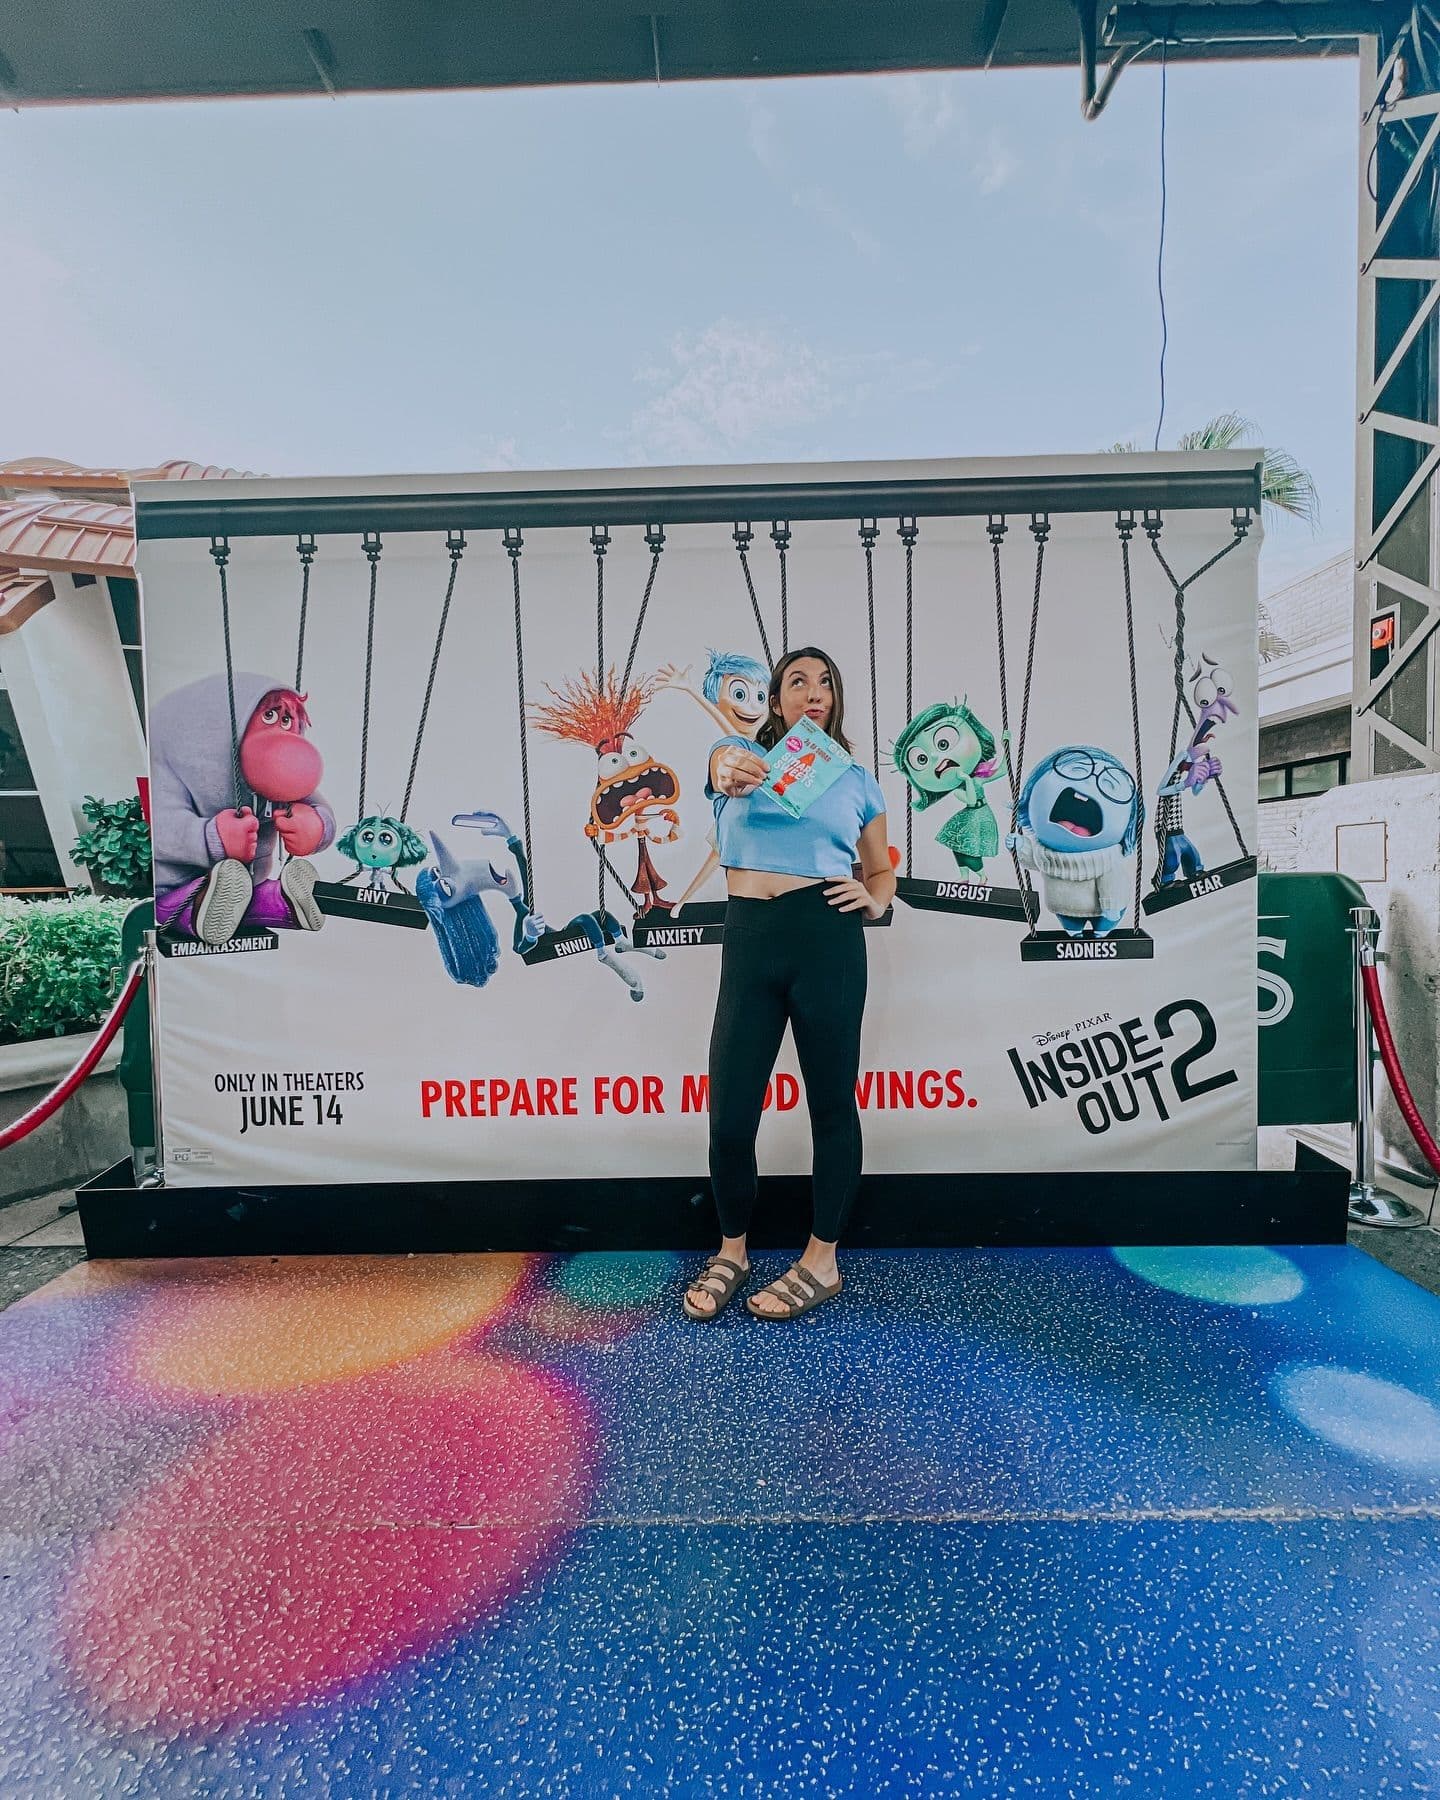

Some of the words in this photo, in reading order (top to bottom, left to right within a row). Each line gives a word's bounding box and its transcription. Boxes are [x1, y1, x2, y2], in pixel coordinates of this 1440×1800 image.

[356, 888, 391, 905] ENVY
[936, 882, 992, 902] DISGUST
[1189, 875, 1224, 899] FEAR
[554, 936, 592, 957] ENNUI
[646, 927, 704, 946] ANXIETY
[1056, 941, 1117, 959] SADNESS
[1075, 1012, 1112, 1032] PIXAR
[1007, 1017, 1164, 1109] INSIDE
[1077, 1060, 1170, 1135] OUT
[1154, 999, 1238, 1102] 2
[214, 1073, 256, 1092] ONLY
[262, 1073, 278, 1092] IN
[283, 1071, 365, 1091] THEATERS
[421, 1077, 578, 1117] PREPARE
[594, 1075, 665, 1115] FOR
[680, 1073, 800, 1113] MD
[855, 1069, 977, 1110] INGS.
[240, 1095, 304, 1134] JUNE
[312, 1094, 343, 1125] 14
[174, 1153, 189, 1161] PG
